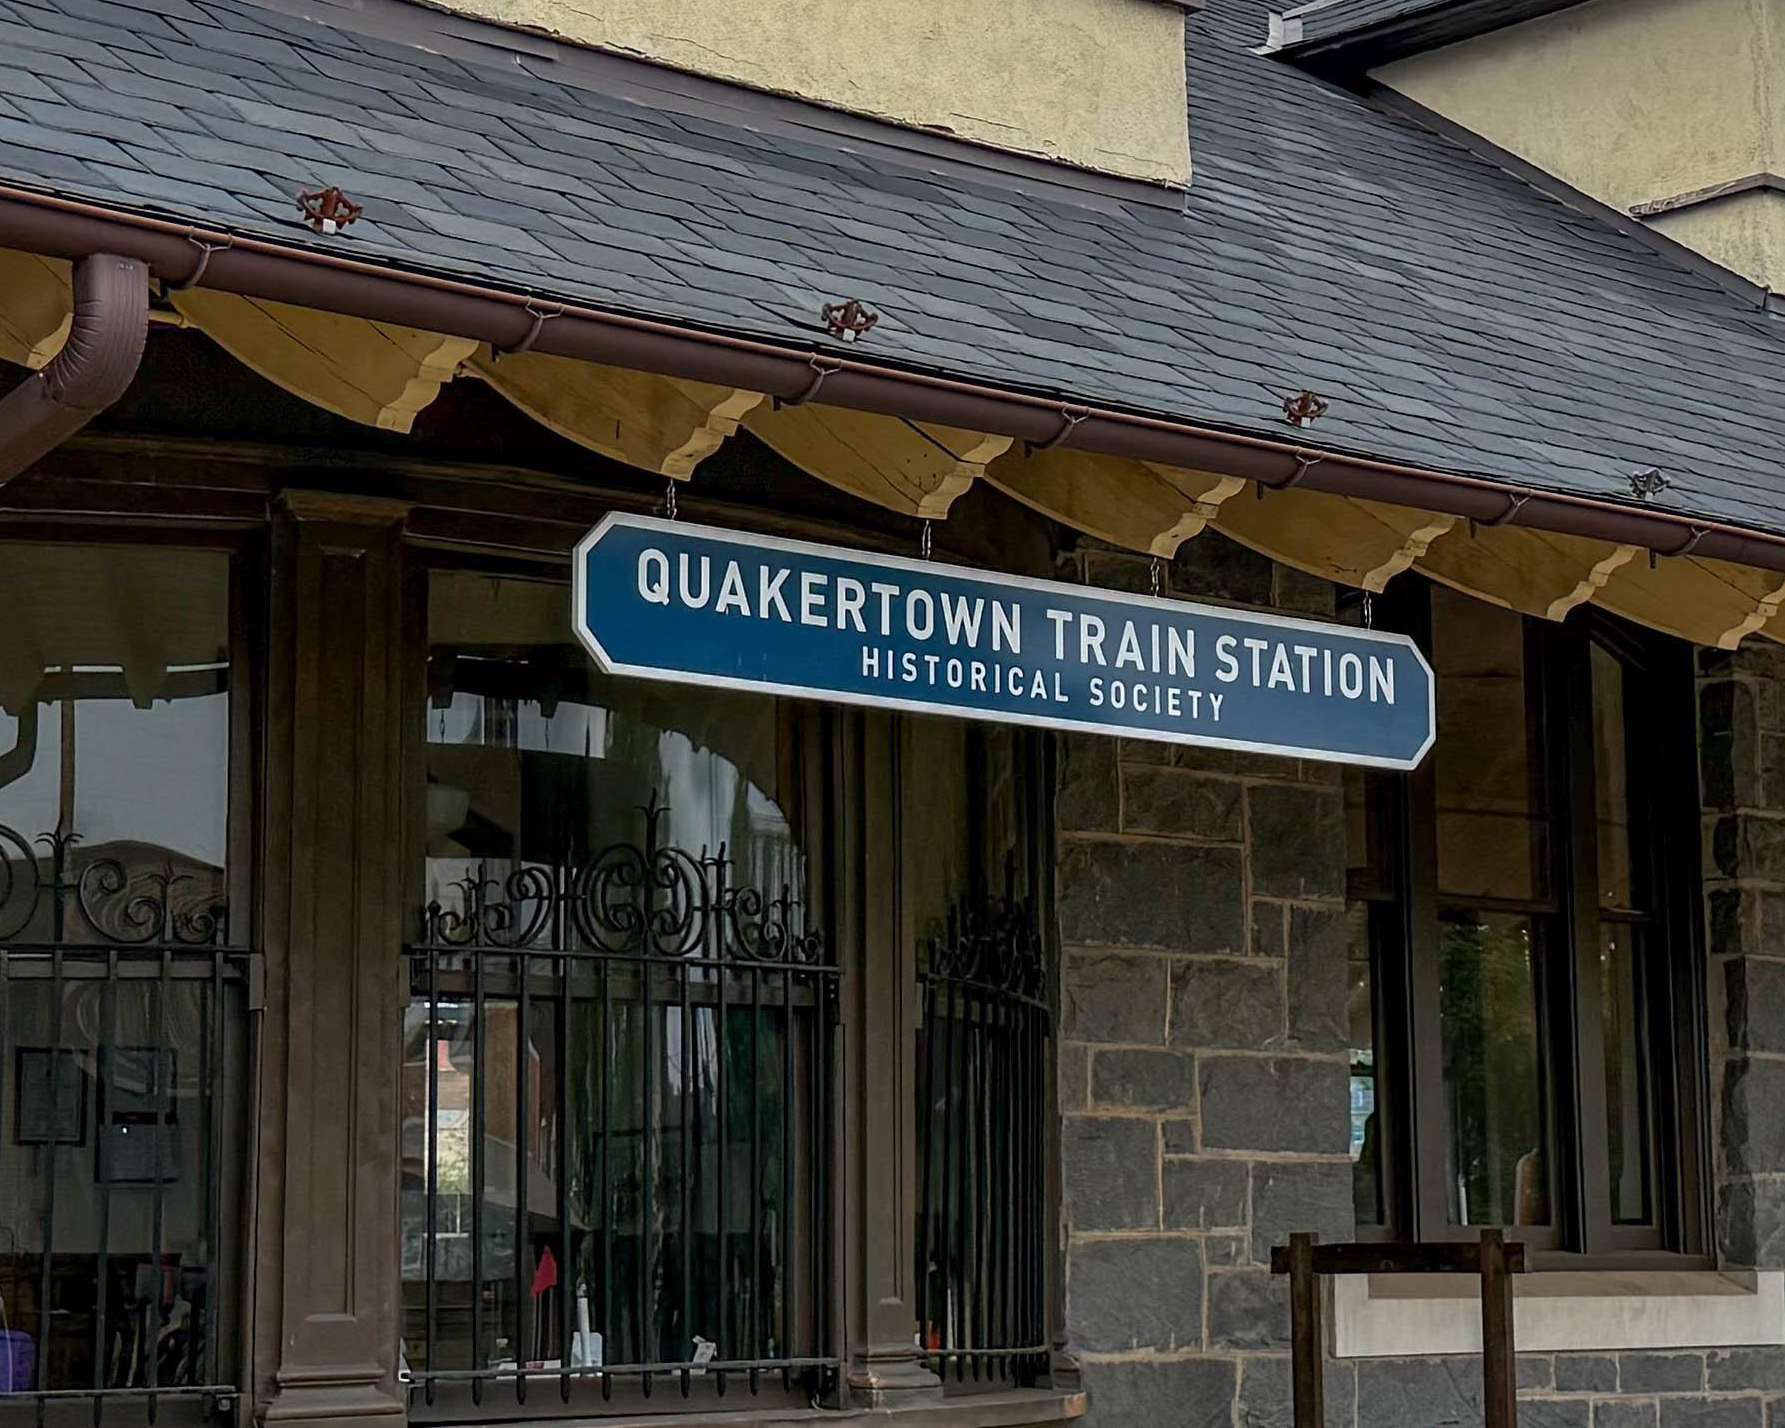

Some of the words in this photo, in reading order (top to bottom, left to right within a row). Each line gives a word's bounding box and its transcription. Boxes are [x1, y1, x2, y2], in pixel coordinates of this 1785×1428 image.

[637, 547, 1022, 655] QUAKERTOWN
[1046, 608, 1196, 679] TRAIN
[1214, 635, 1396, 705] STATION
[862, 646, 1070, 703] HISTORICAL
[1089, 677, 1225, 723] SOCIETY
